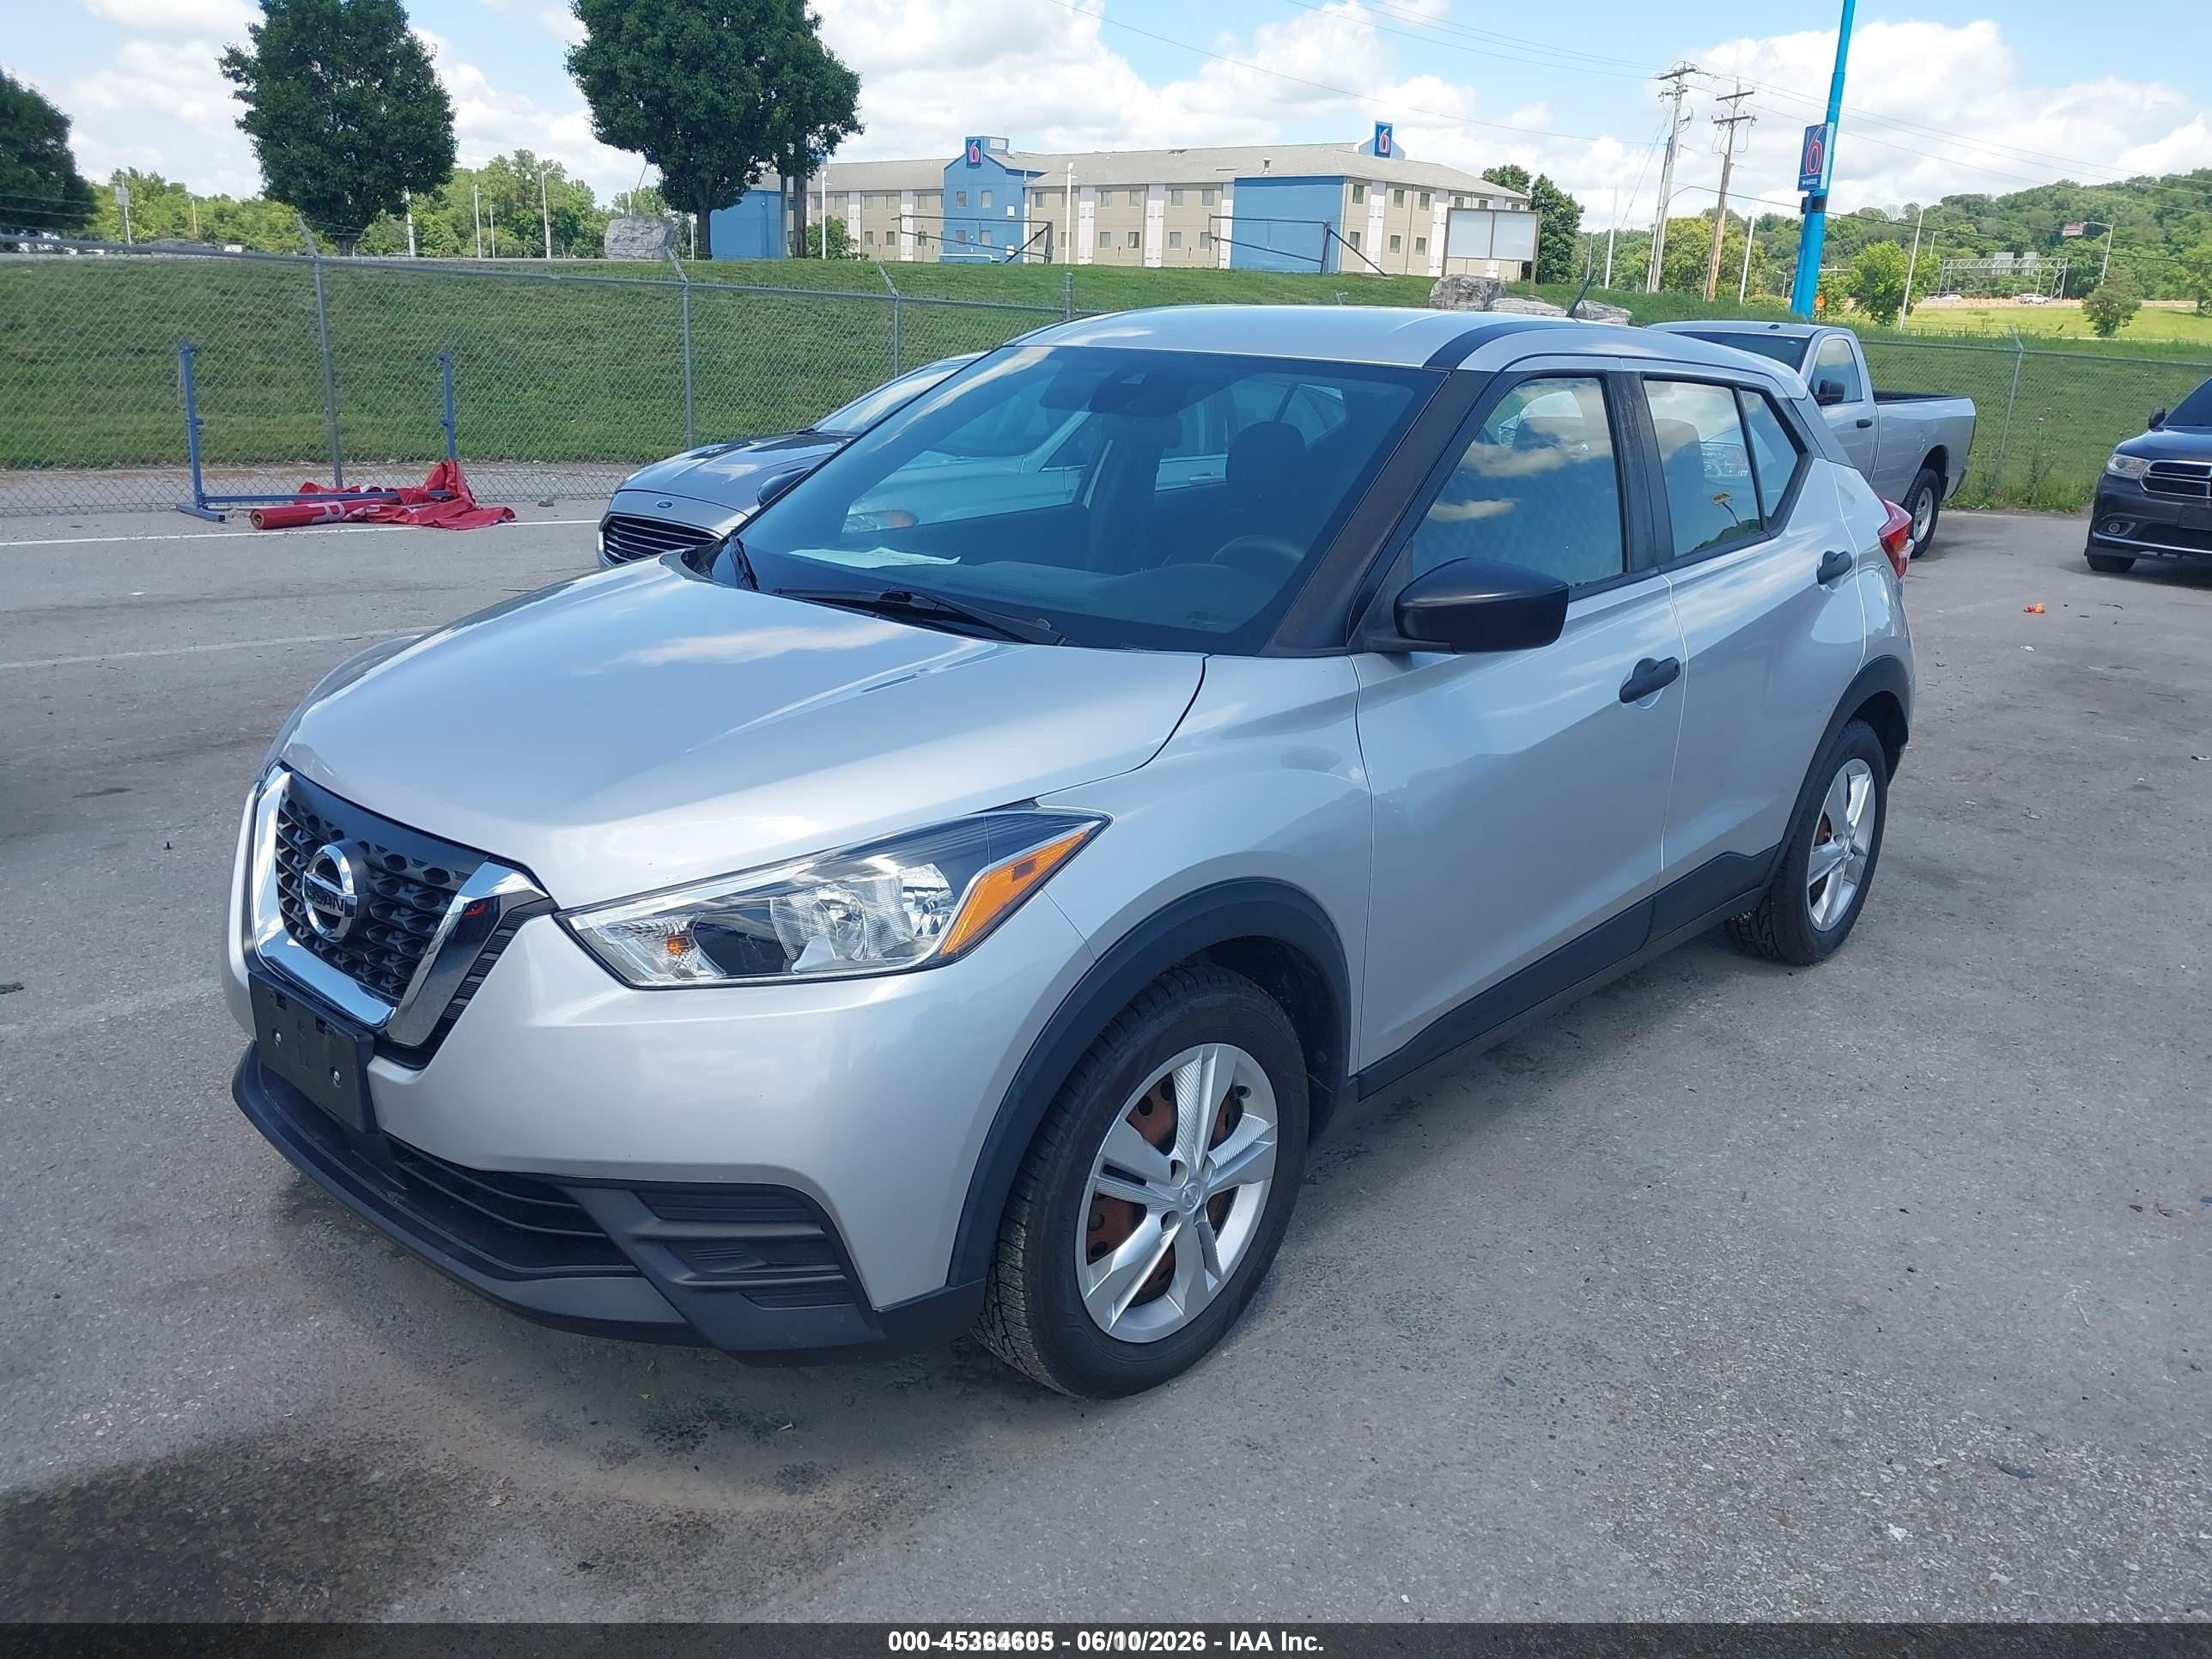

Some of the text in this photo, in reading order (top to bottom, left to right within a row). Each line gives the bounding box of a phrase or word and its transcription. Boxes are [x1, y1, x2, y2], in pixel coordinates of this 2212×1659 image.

[969, 140, 980, 164] 6
[1379, 128, 1390, 154] 6
[1805, 125, 1827, 175] 6
